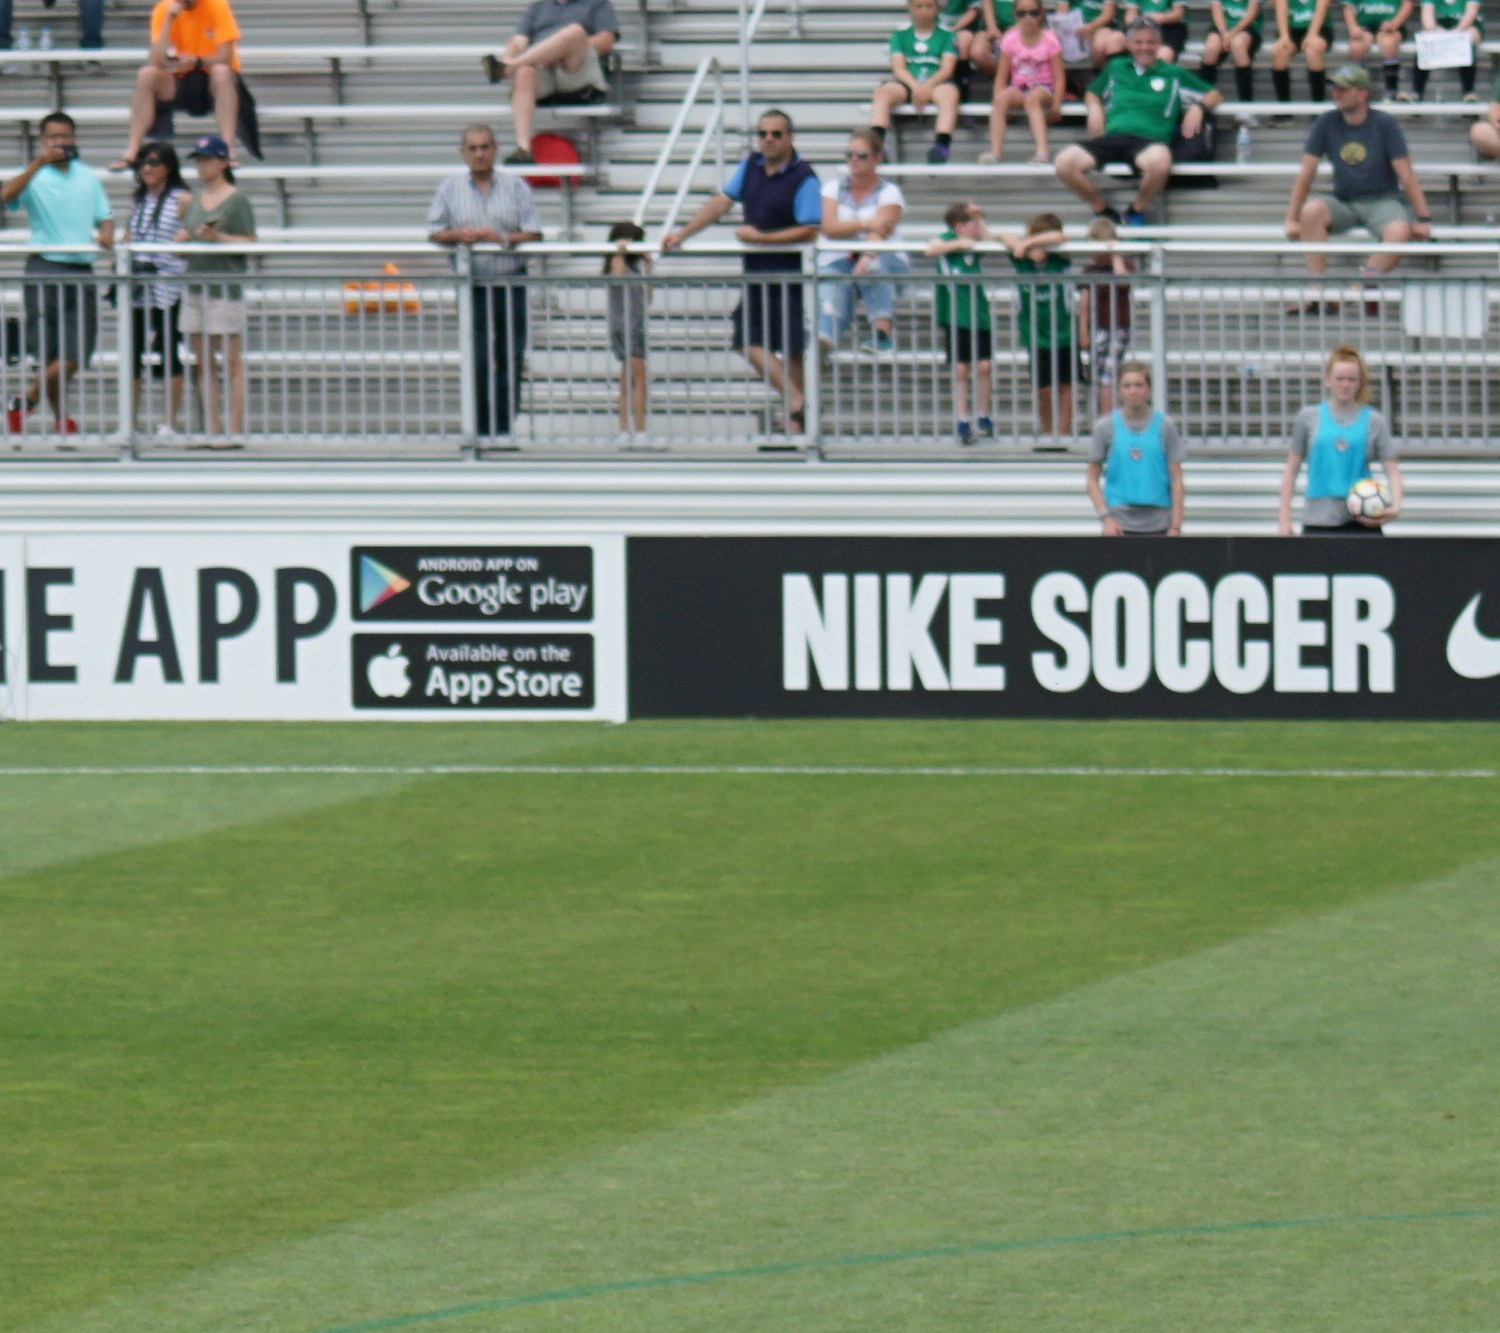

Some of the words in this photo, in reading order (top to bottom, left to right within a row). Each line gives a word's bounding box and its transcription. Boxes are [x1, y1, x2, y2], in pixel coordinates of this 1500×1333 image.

[417, 557, 483, 572] ANDROID
[486, 557, 513, 572] APP
[515, 557, 540, 572] ON
[416, 574, 522, 616] Google
[529, 577, 588, 613] play
[113, 566, 338, 685] APP
[781, 572, 1006, 691] NIKE
[1030, 570, 1396, 695] SOCCER
[426, 643, 508, 662] Available
[512, 647, 537, 662] on
[540, 643, 571, 662] the
[425, 664, 494, 705] App
[496, 664, 584, 698] Store
